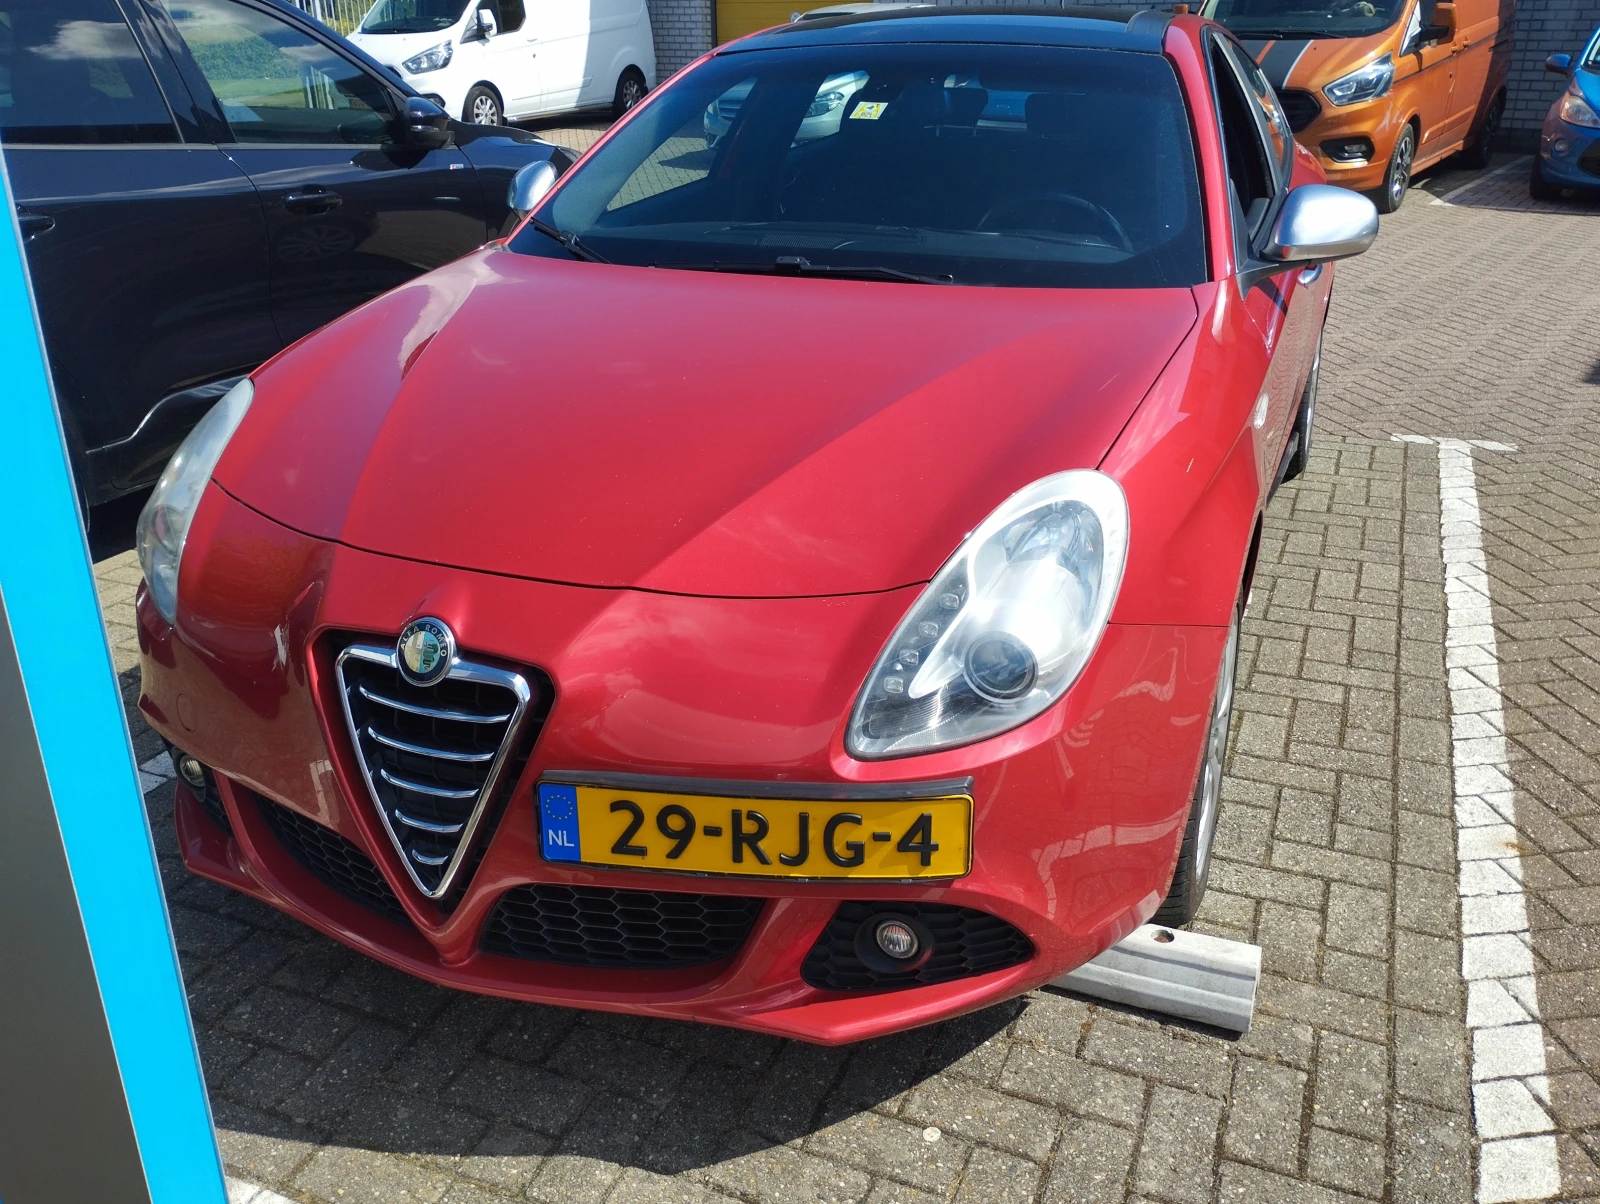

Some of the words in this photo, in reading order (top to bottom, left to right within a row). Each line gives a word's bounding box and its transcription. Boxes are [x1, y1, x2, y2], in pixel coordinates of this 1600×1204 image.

[400, 625, 420, 651] ALFA
[424, 624, 447, 657] ROMEO
[548, 829, 575, 847] NL
[609, 799, 939, 868] 29-RJG-4
